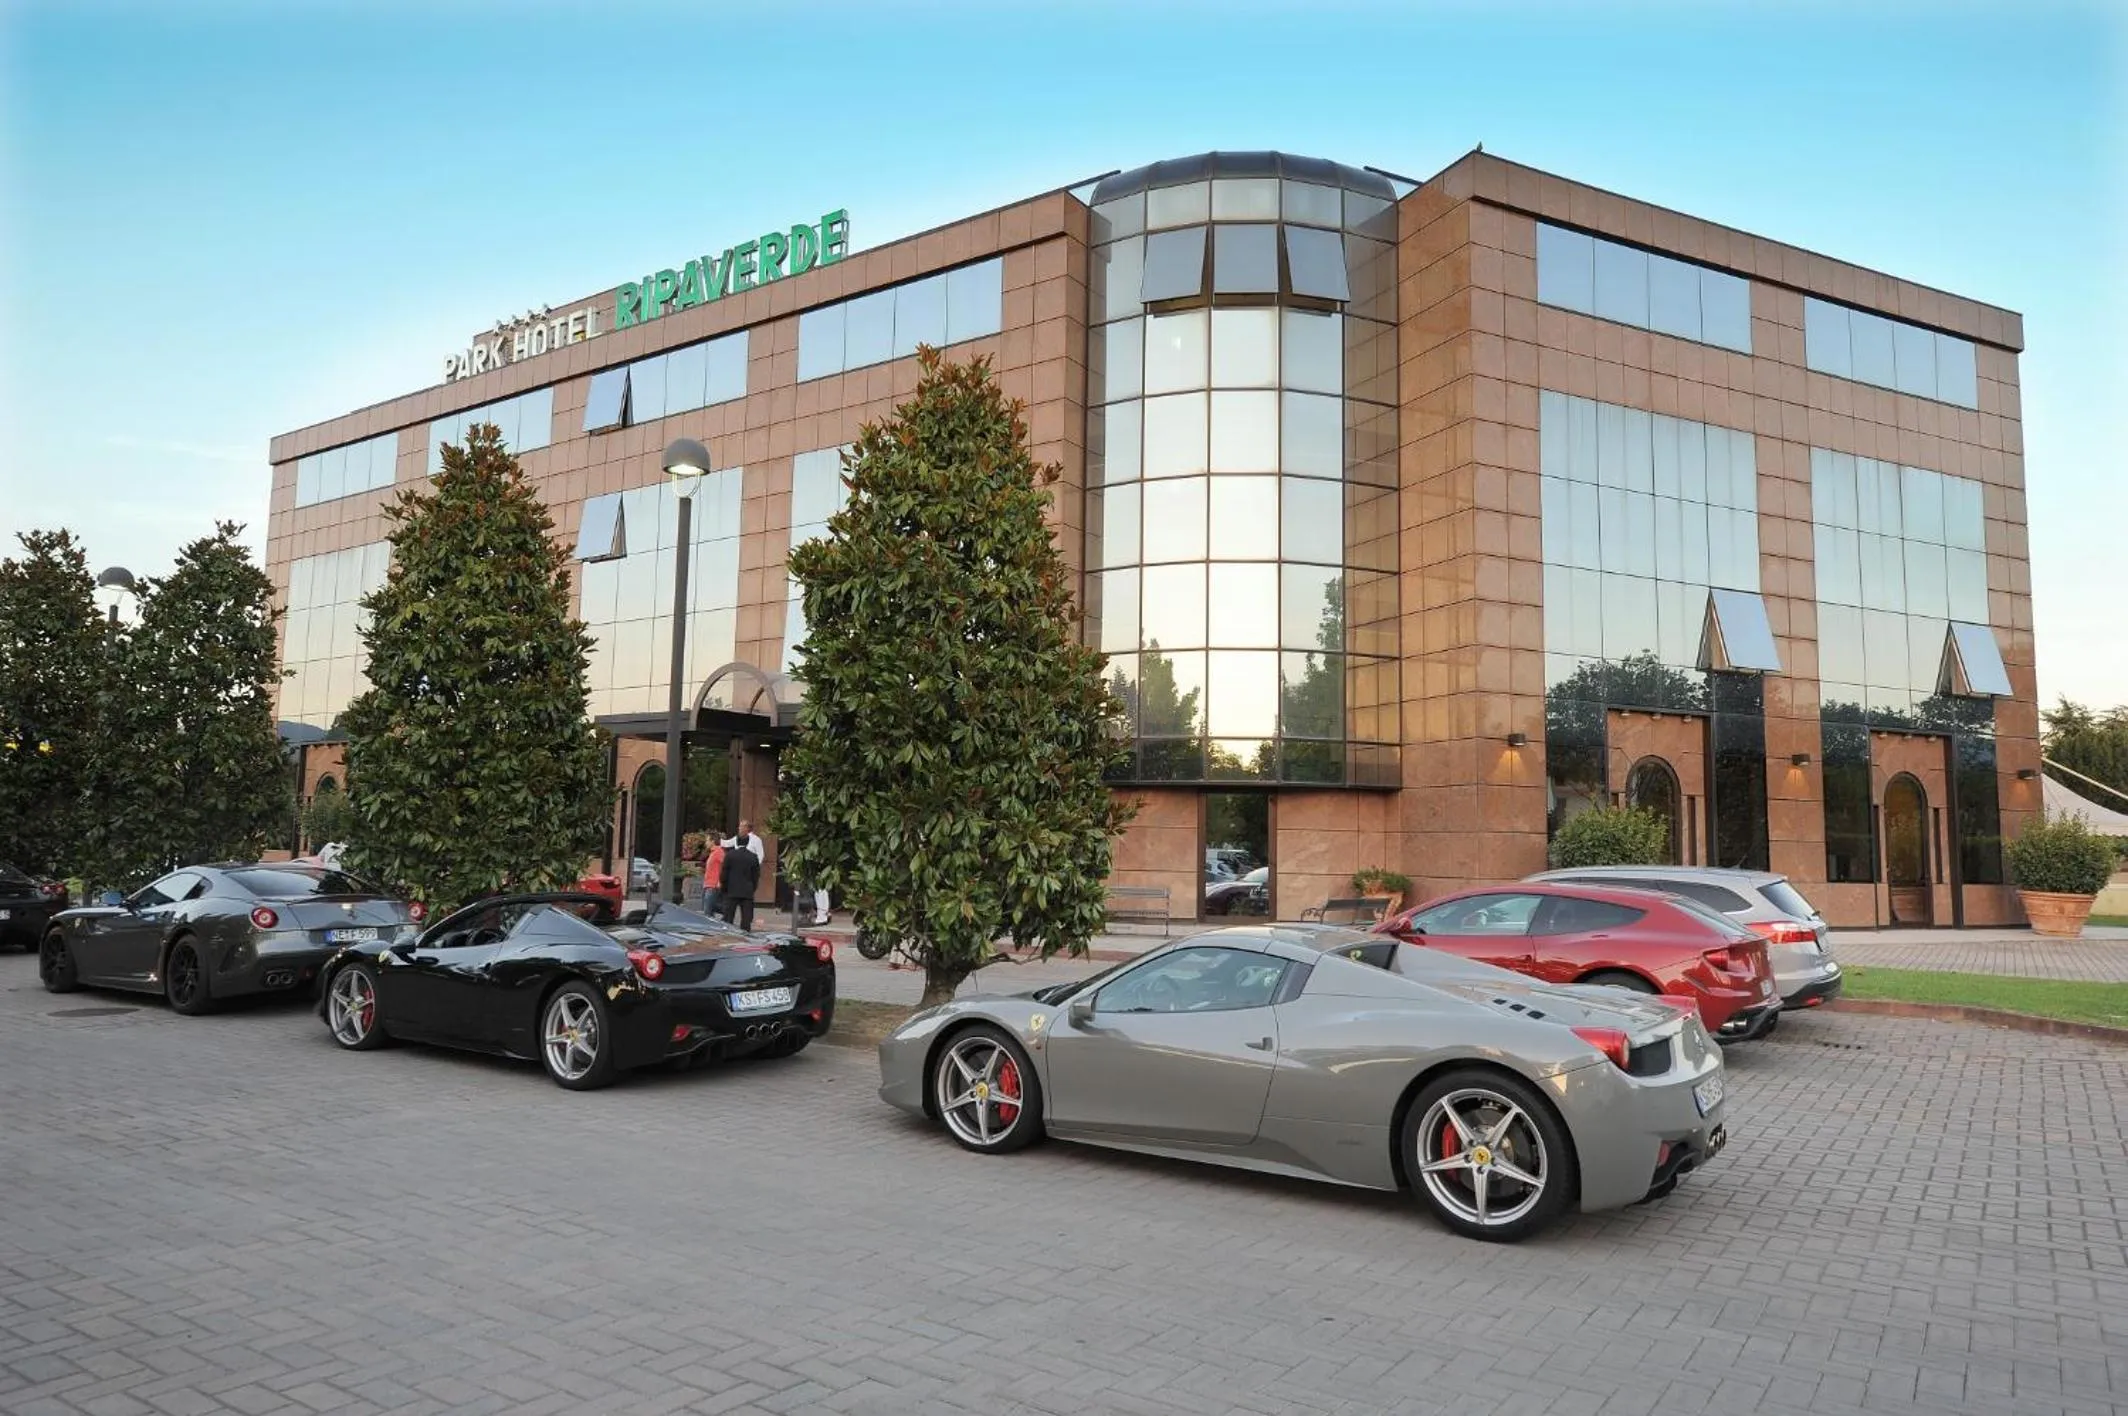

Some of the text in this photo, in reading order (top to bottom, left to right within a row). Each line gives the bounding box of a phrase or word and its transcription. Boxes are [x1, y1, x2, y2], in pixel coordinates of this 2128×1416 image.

[444, 208, 848, 384] PARK HOTEL RIPAVERDE
